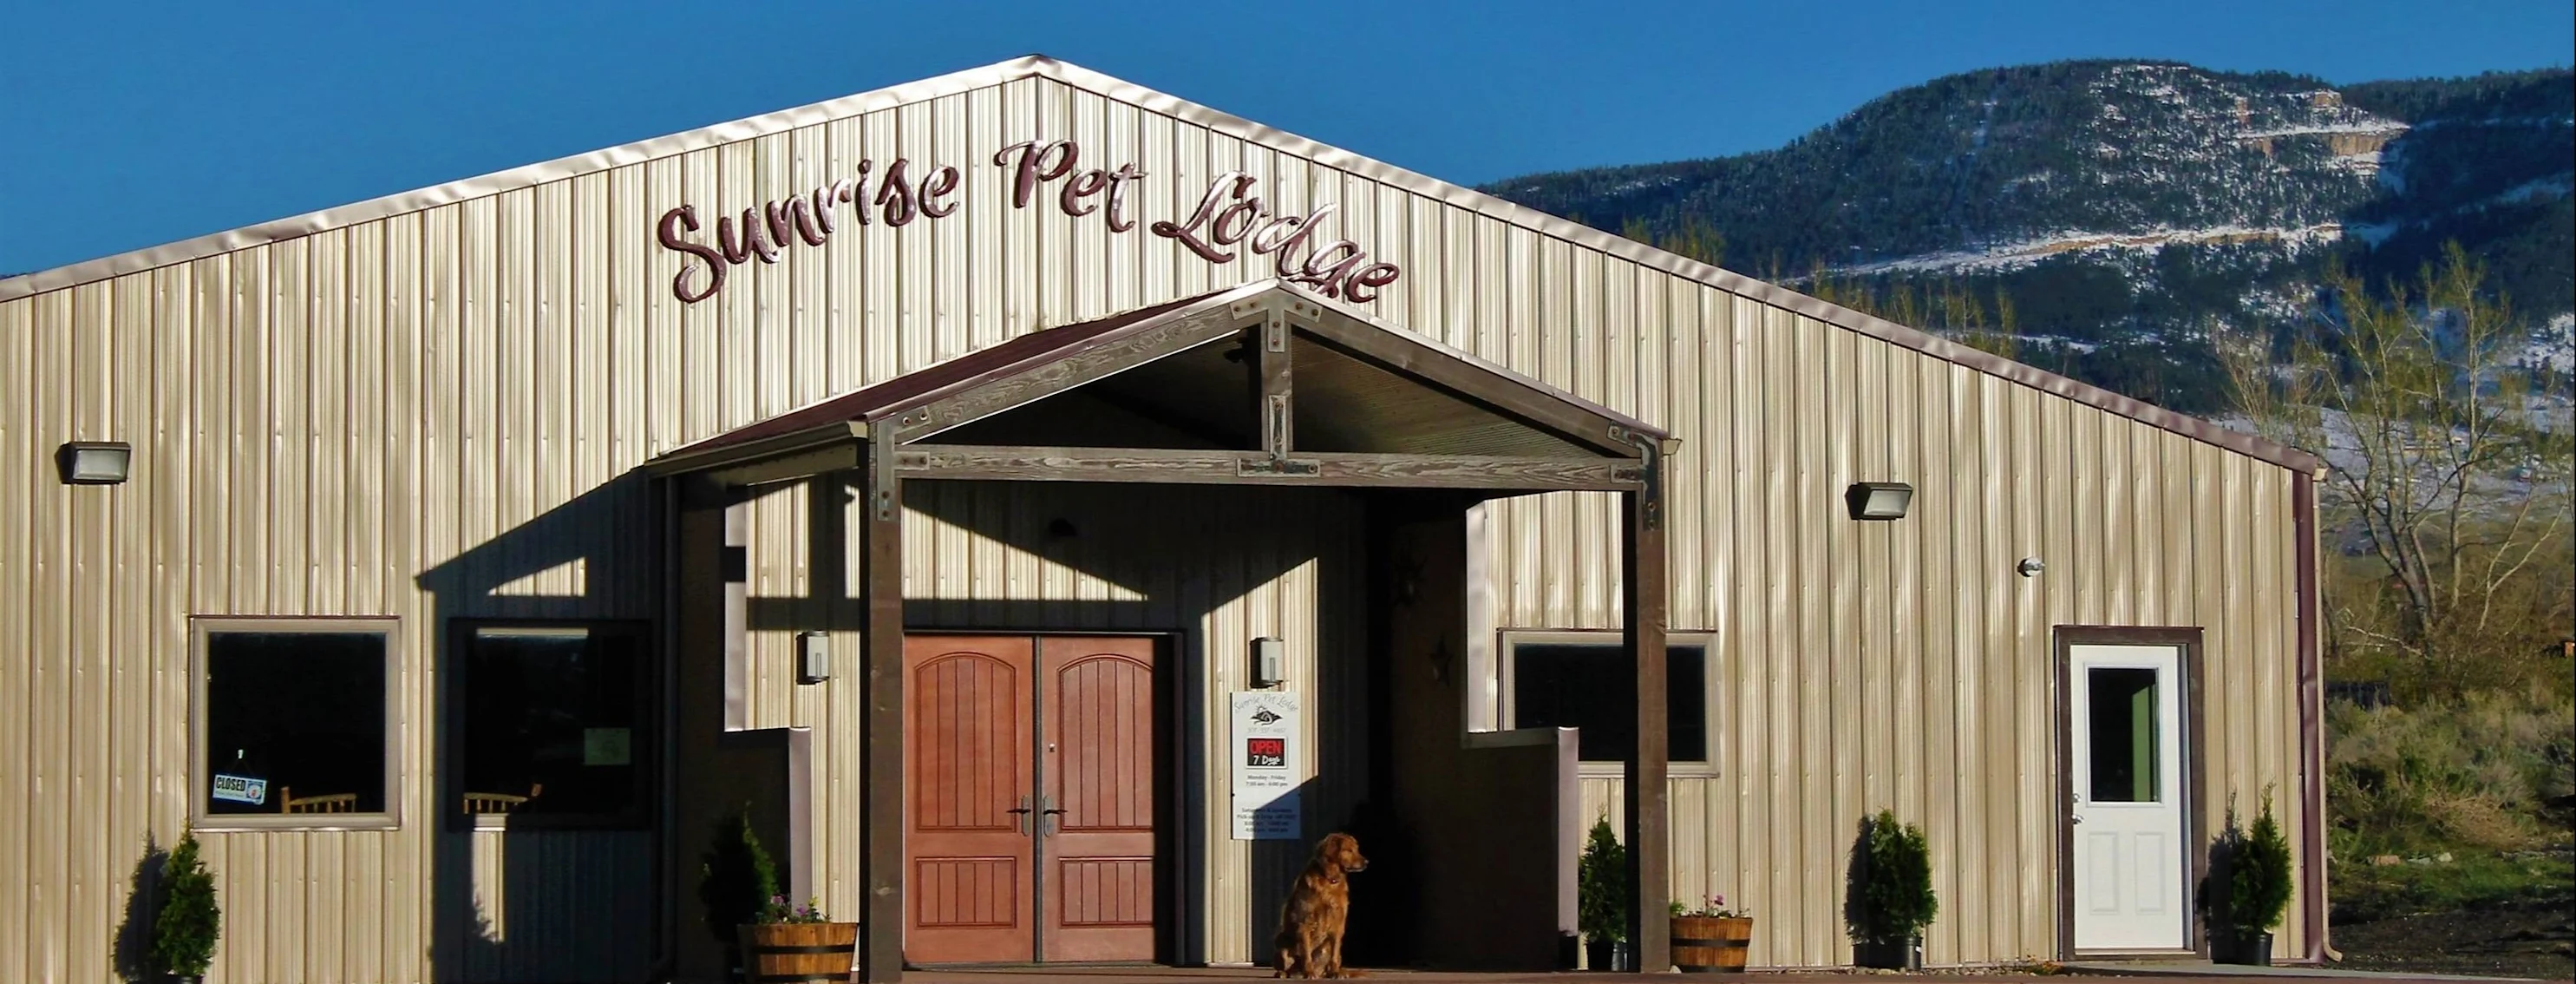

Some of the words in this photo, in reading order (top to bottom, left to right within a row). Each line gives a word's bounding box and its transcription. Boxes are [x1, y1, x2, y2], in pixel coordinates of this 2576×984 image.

[657, 158, 960, 304] Sunrise
[994, 139, 1148, 233] Pet
[1151, 170, 1400, 303] Lodge
[1264, 693, 1277, 705] Pet
[1250, 740, 1282, 754] OPEN
[1253, 755, 1260, 764] 7
[216, 777, 246, 791] CLOSED
